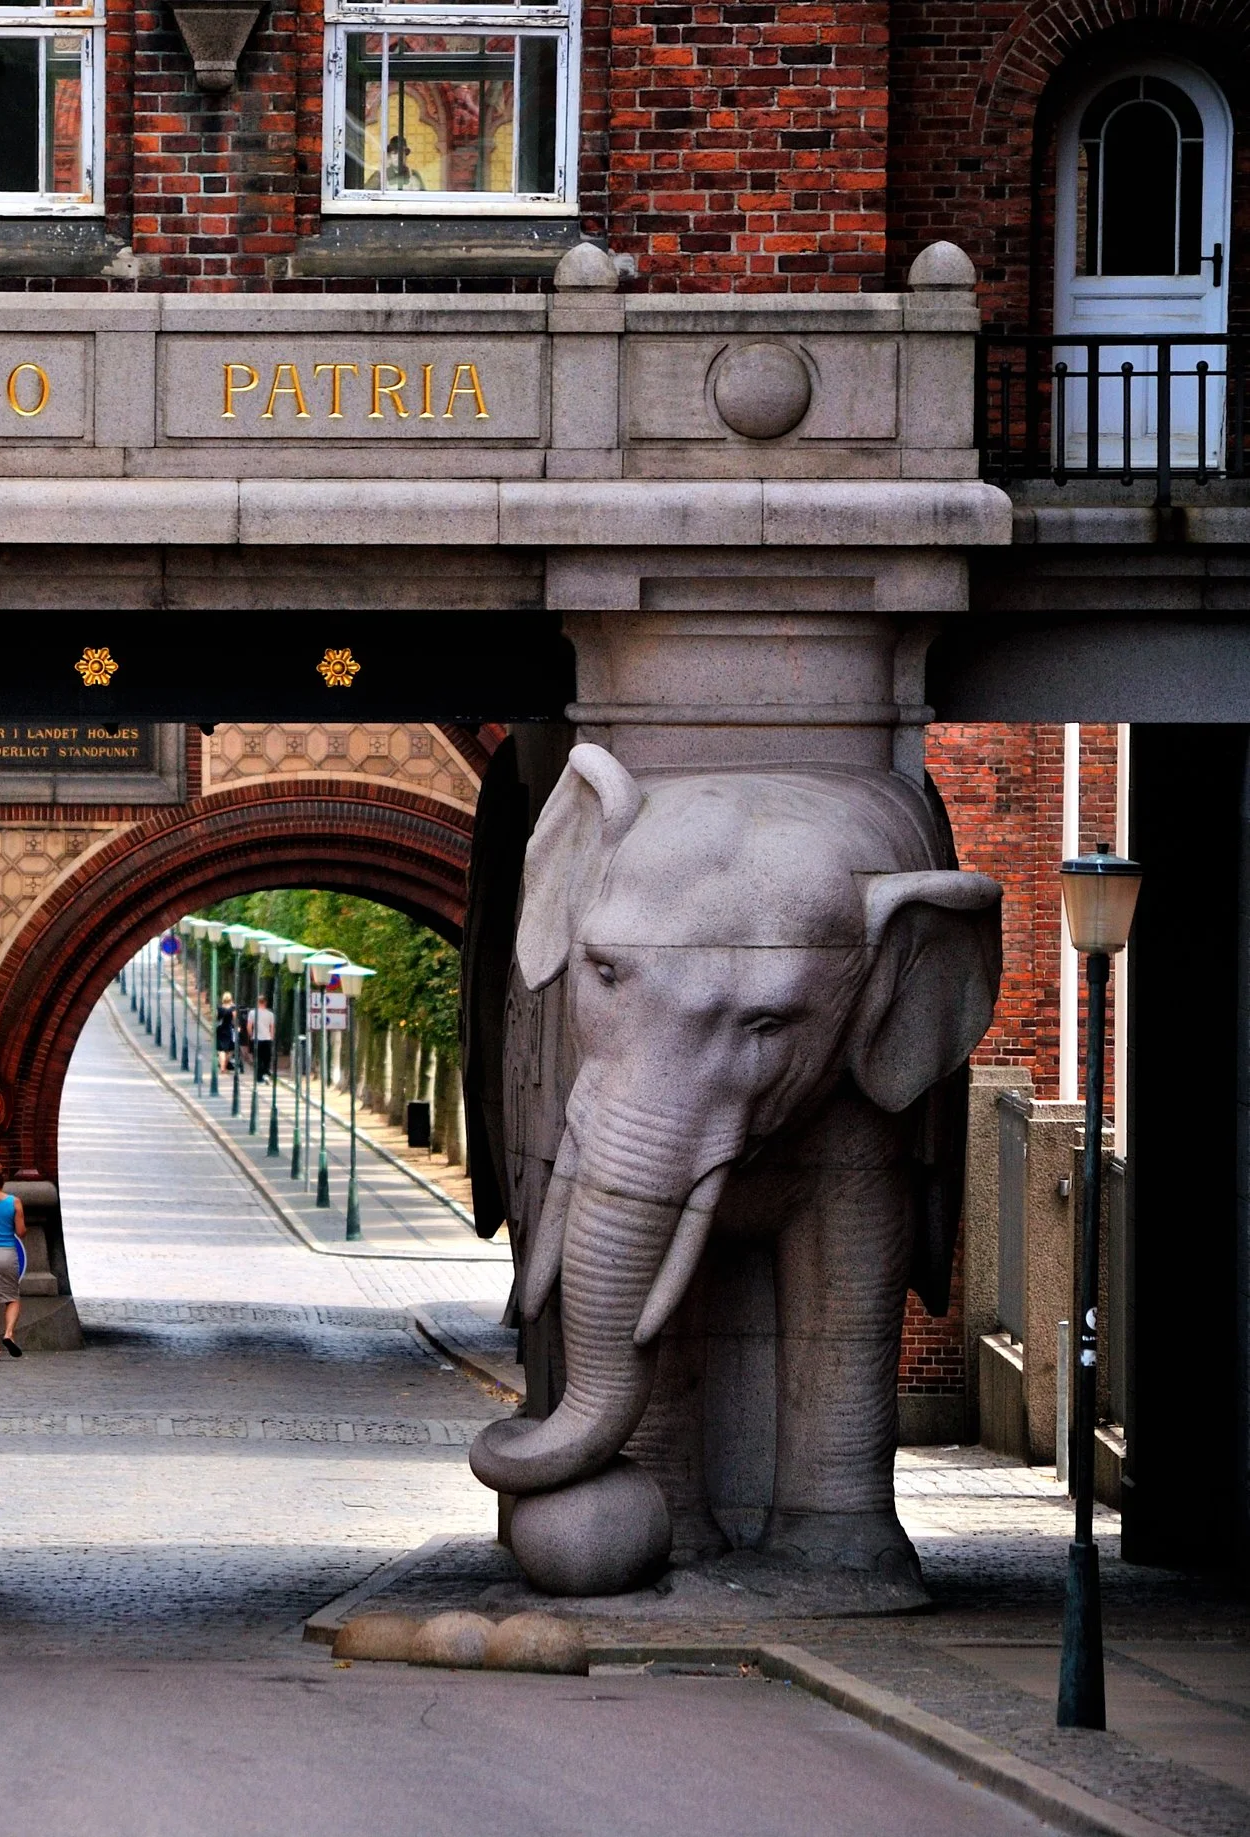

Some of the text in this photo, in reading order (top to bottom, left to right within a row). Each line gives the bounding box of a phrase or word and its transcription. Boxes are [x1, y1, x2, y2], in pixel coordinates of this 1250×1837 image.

[220, 362, 491, 419] PATRIA
[13, 728, 18, 739] I
[27, 728, 78, 739] LANDET
[58, 746, 139, 757] STANDPUNKT
